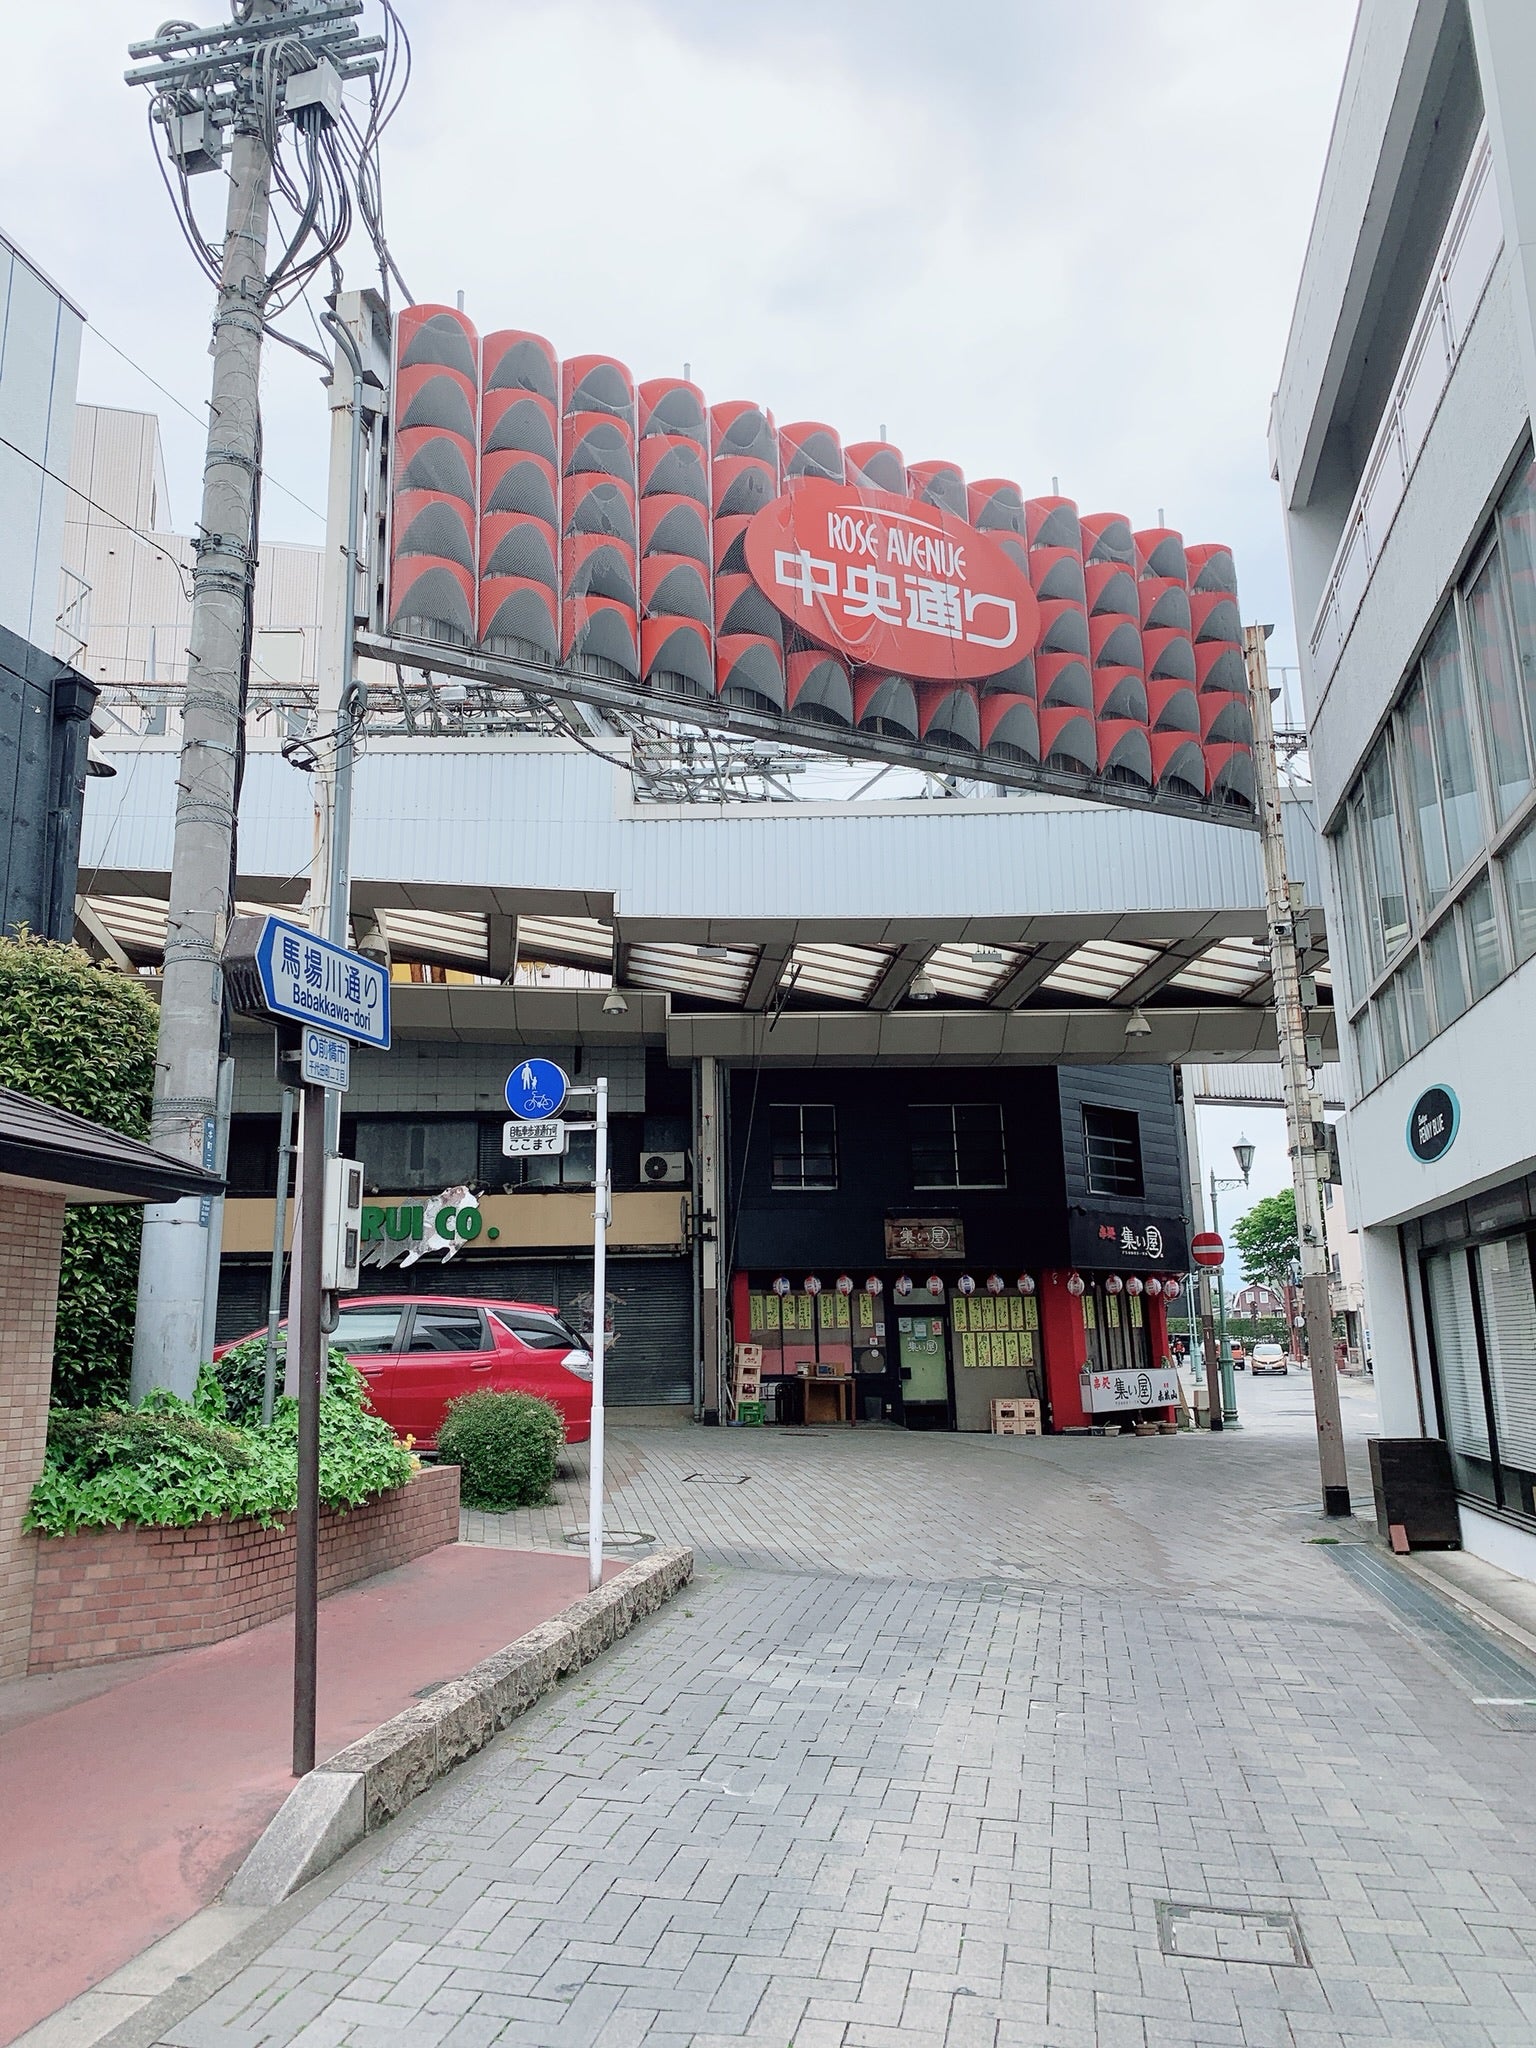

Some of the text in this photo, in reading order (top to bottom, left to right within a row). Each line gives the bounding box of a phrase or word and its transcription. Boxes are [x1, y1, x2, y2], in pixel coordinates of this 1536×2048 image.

[828, 512, 967, 581] ROSE AVENUE
[774, 549, 1018, 649] 中央通り
[281, 936, 377, 1009] 馬場川通り
[293, 983, 371, 1031] Babakkawa-dori
[319, 1038, 346, 1064] 前橋市
[509, 1138, 557, 1151] ここまで
[435, 1206, 500, 1240] CO.
[1120, 1225, 1162, 1256] 集い屋
[1114, 1374, 1152, 1403] 集い屋
